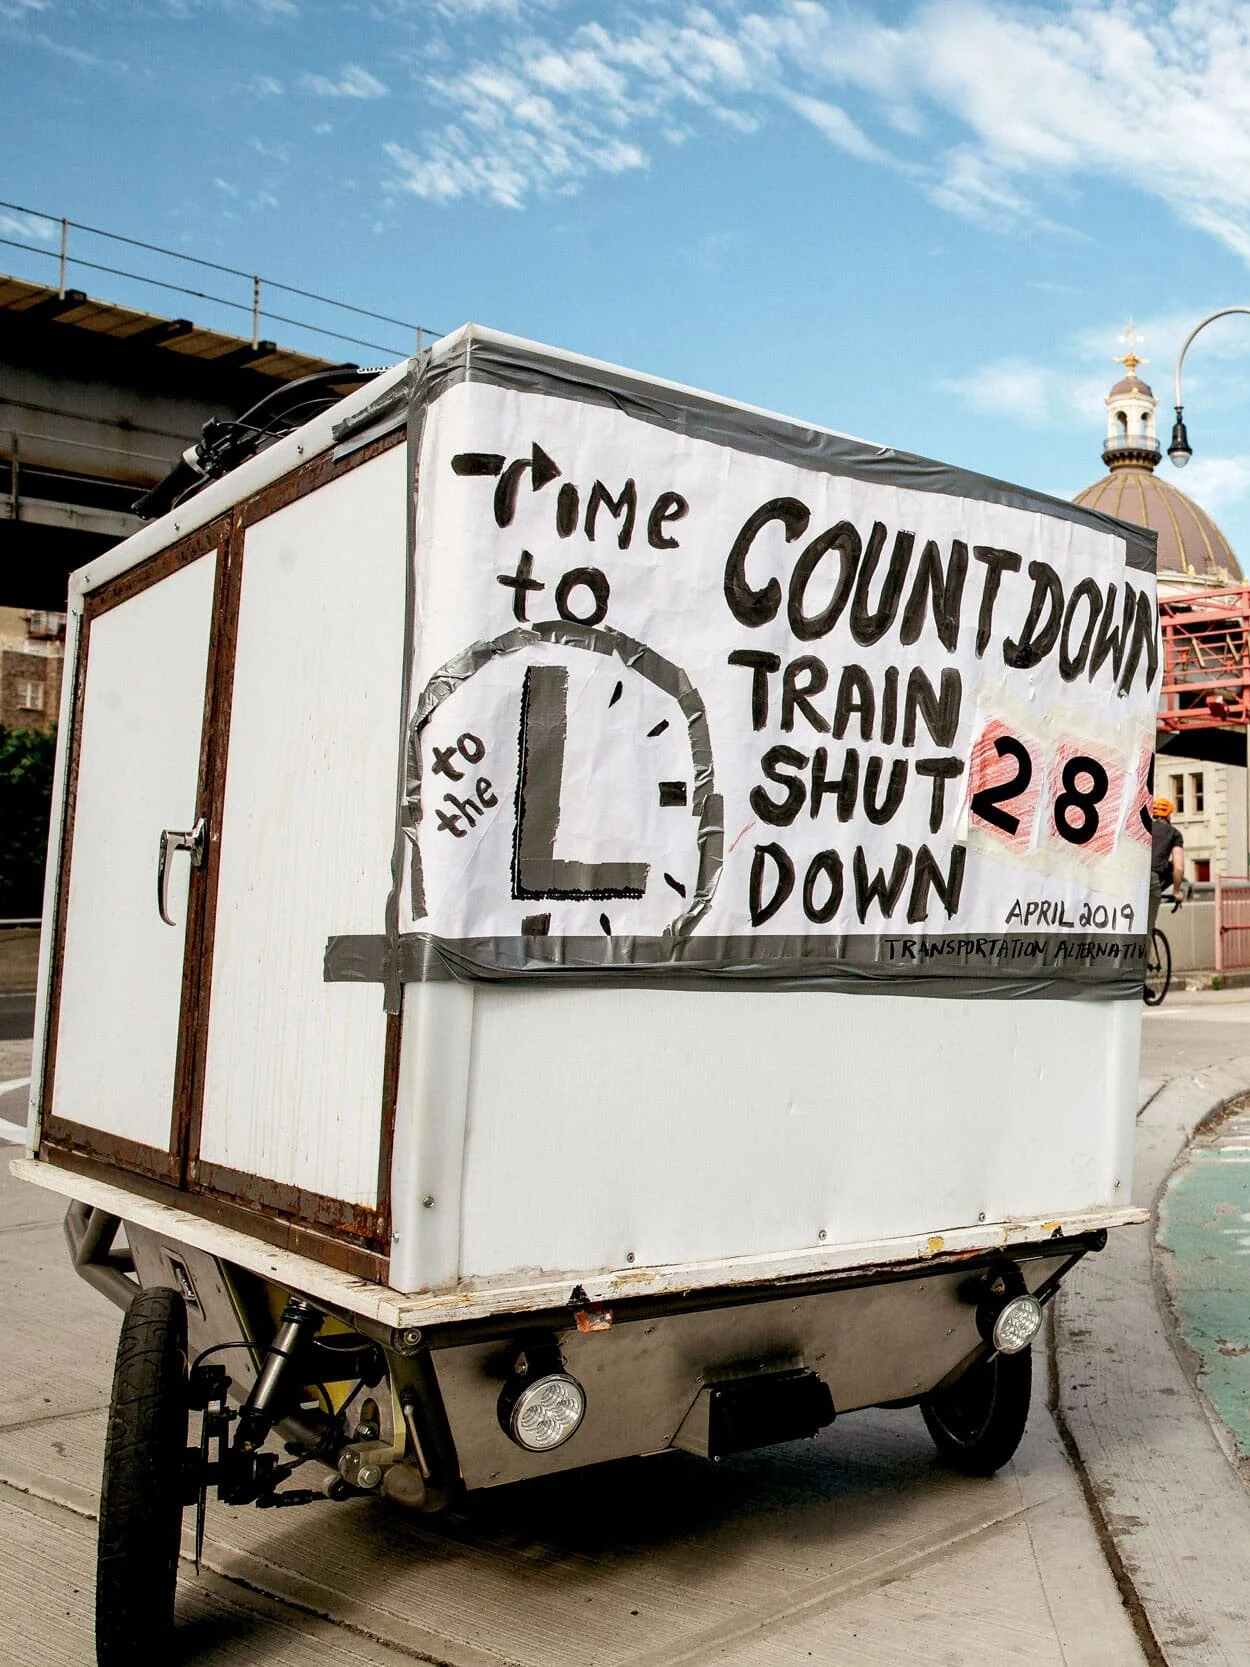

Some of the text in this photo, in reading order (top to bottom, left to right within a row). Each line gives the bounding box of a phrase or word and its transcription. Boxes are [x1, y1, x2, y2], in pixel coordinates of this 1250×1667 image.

[497, 550, 611, 627] to
[727, 649, 963, 748] TRAIN
[431, 732, 486, 782] to
[510, 664, 651, 901] L
[749, 744, 965, 834] SHUT
[435, 777, 498, 838] the
[750, 843, 967, 926] DOWN
[1005, 898, 1135, 932] APRIL 2019
[885, 938, 1047, 961] TRANSPORTATION
